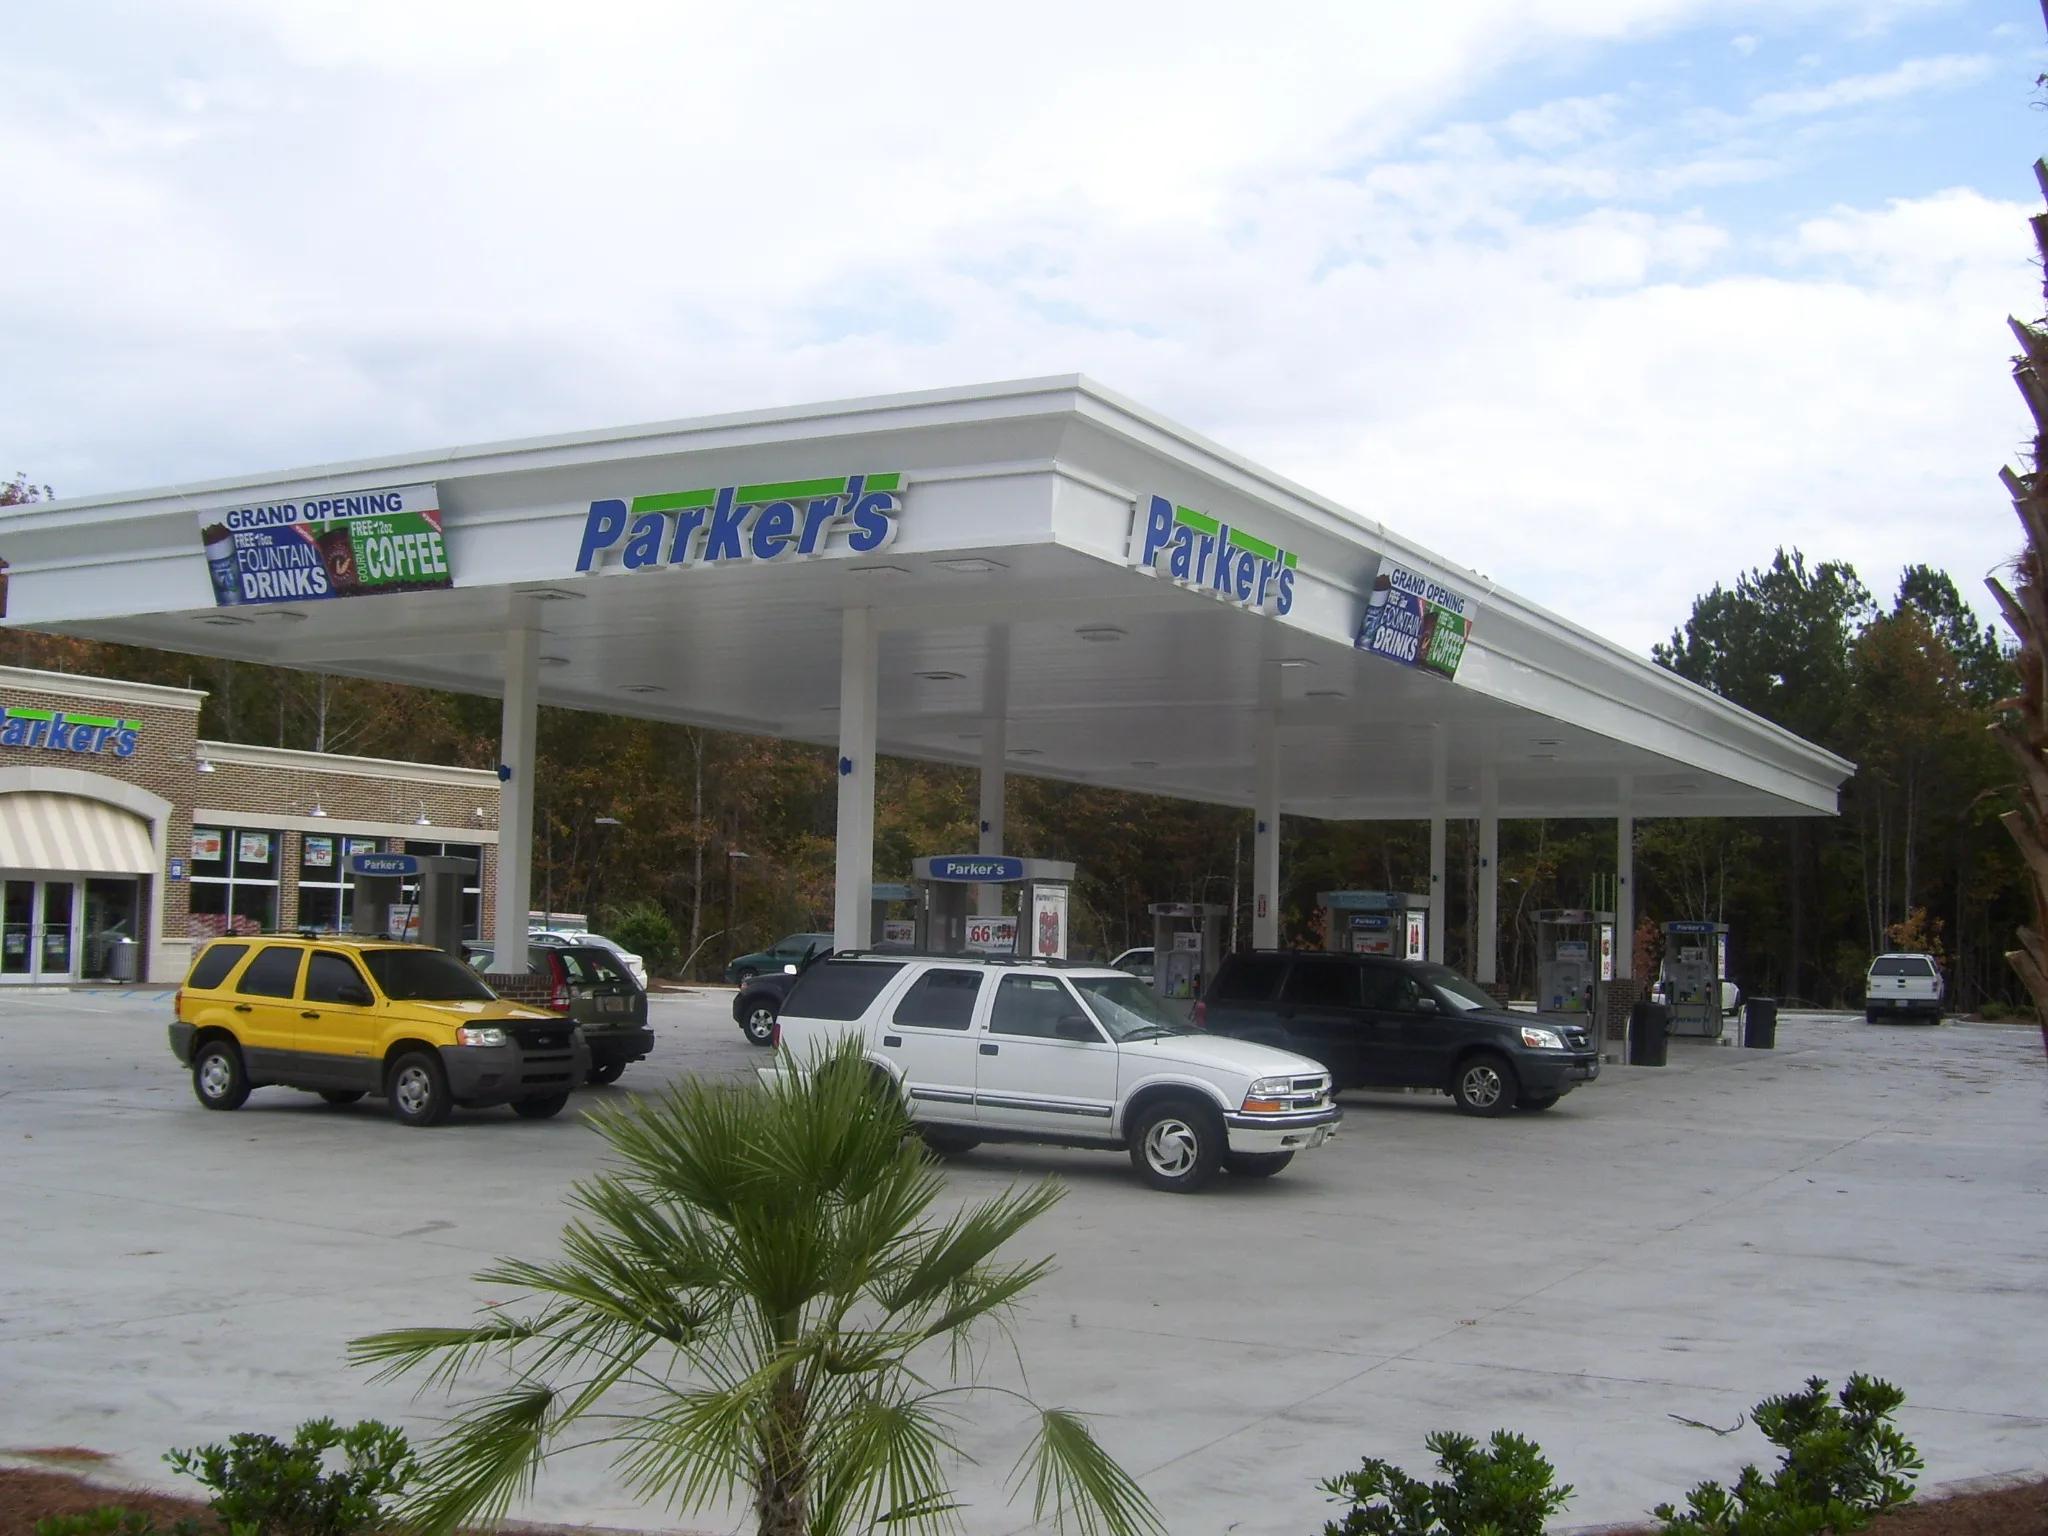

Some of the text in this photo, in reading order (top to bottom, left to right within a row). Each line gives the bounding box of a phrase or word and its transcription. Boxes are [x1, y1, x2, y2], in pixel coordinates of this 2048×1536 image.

[226, 492, 403, 529] GRAND OPENING
[350, 519, 374, 537] FREE
[575, 475, 894, 572] Parker's
[233, 532, 257, 549] FREE
[236, 543, 318, 572] FOUNTAIN
[366, 532, 448, 578] COFFEE
[1143, 495, 1295, 616] Parker's
[353, 538, 369, 582] GOURMET
[242, 566, 327, 599] DRINKS
[1391, 568, 1426, 596] GRAND
[1427, 583, 1465, 614] OPENING
[1380, 604, 1422, 637] FOUNTAIN
[1373, 625, 1419, 661] DRINKS
[0, 707, 138, 757] arker's
[364, 859, 405, 871] Parker's
[946, 862, 1005, 876] Parker's
